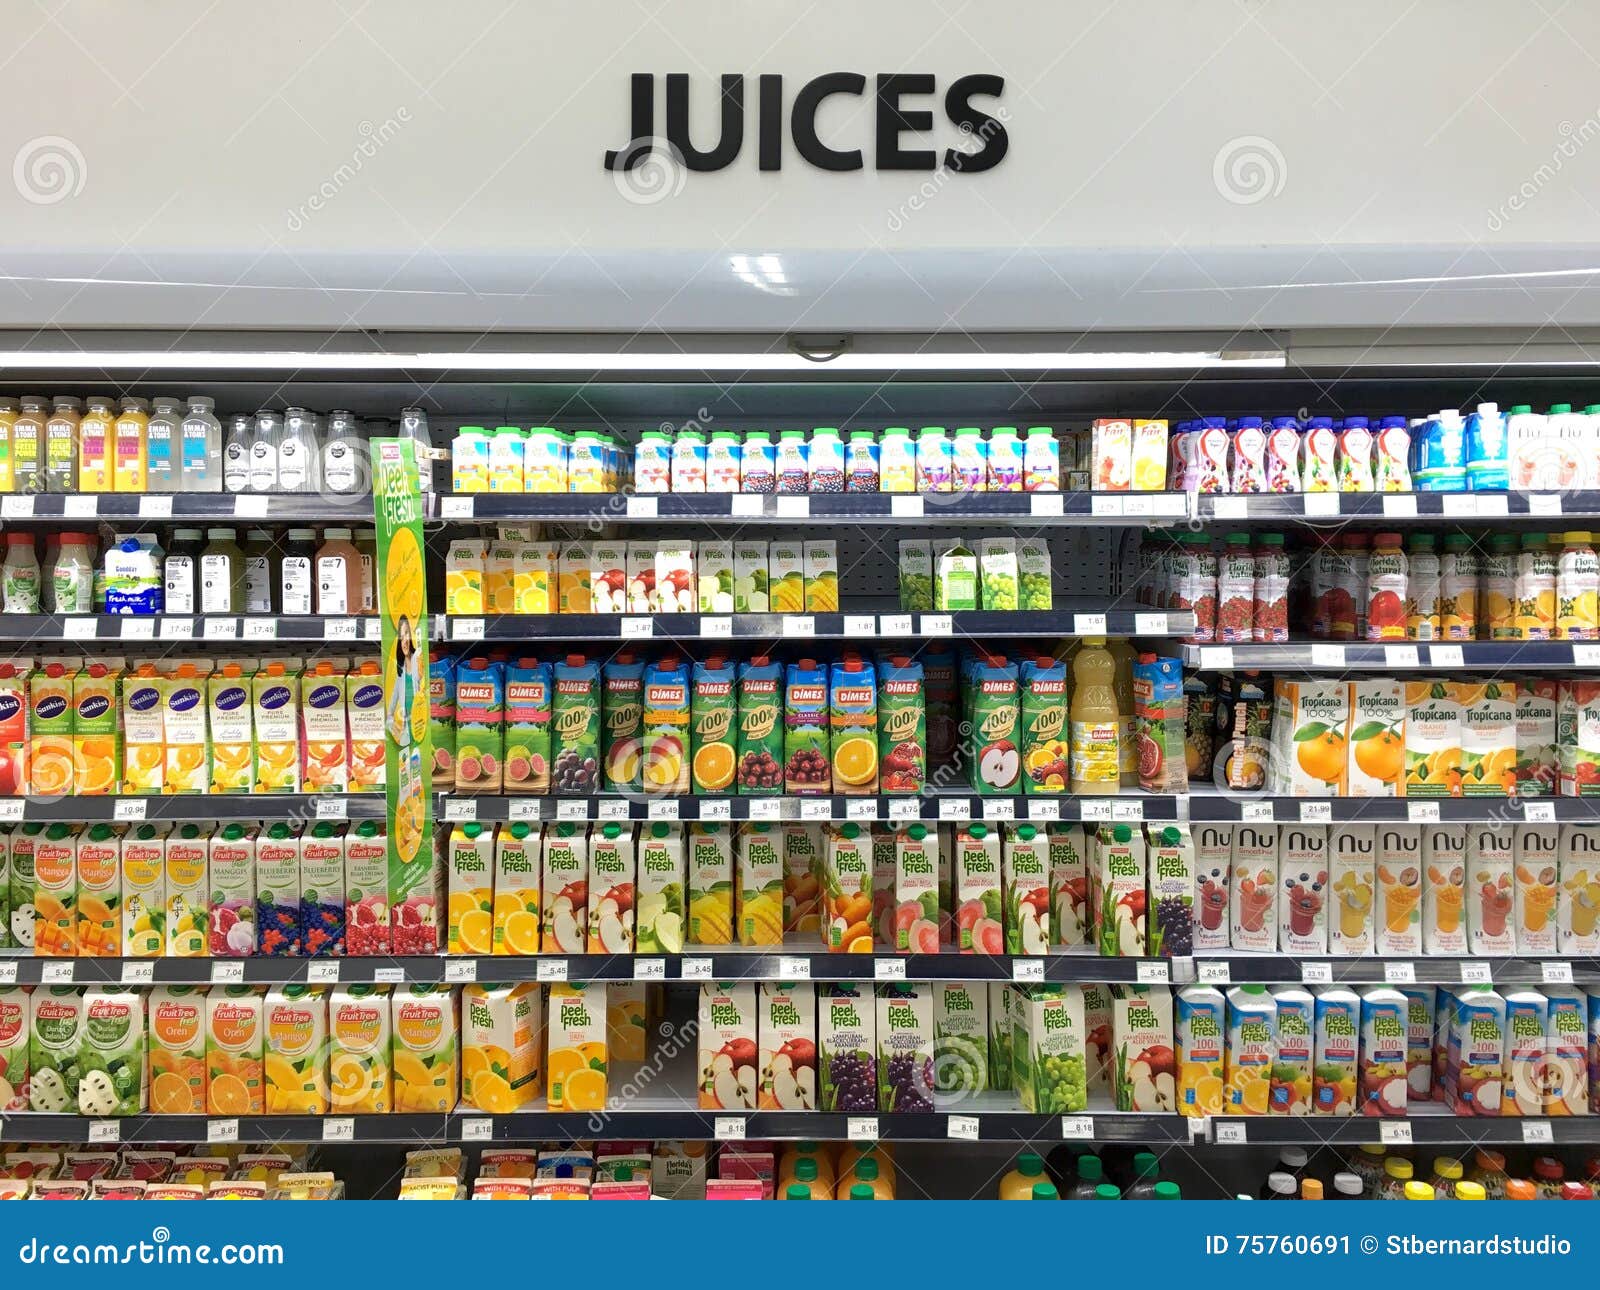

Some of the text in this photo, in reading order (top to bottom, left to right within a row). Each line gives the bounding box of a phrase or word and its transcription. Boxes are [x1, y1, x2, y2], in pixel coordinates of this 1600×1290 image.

[604, 72, 1009, 173] JUICES
[181, 559, 188, 567] 4
[299, 559, 305, 568] 4
[336, 559, 341, 568] 7
[130, 691, 159, 706] Sunkist
[170, 693, 200, 707] Sunkist
[216, 691, 246, 706] Sunkist
[260, 690, 290, 706] Sunkist
[308, 689, 339, 705] Sunkist
[354, 689, 383, 705] Sunkist
[1301, 696, 1341, 708] Tropicana
[1359, 695, 1398, 708] Tropicana
[36, 699, 66, 715] Sunkist
[79, 699, 109, 714] Sunkist
[1364, 708, 1393, 717] 100%
[1305, 709, 1335, 718] 100%
[1410, 709, 1456, 722] Tropicana
[1467, 709, 1511, 722] Tropicana
[322, 968, 337, 976] 7.04
